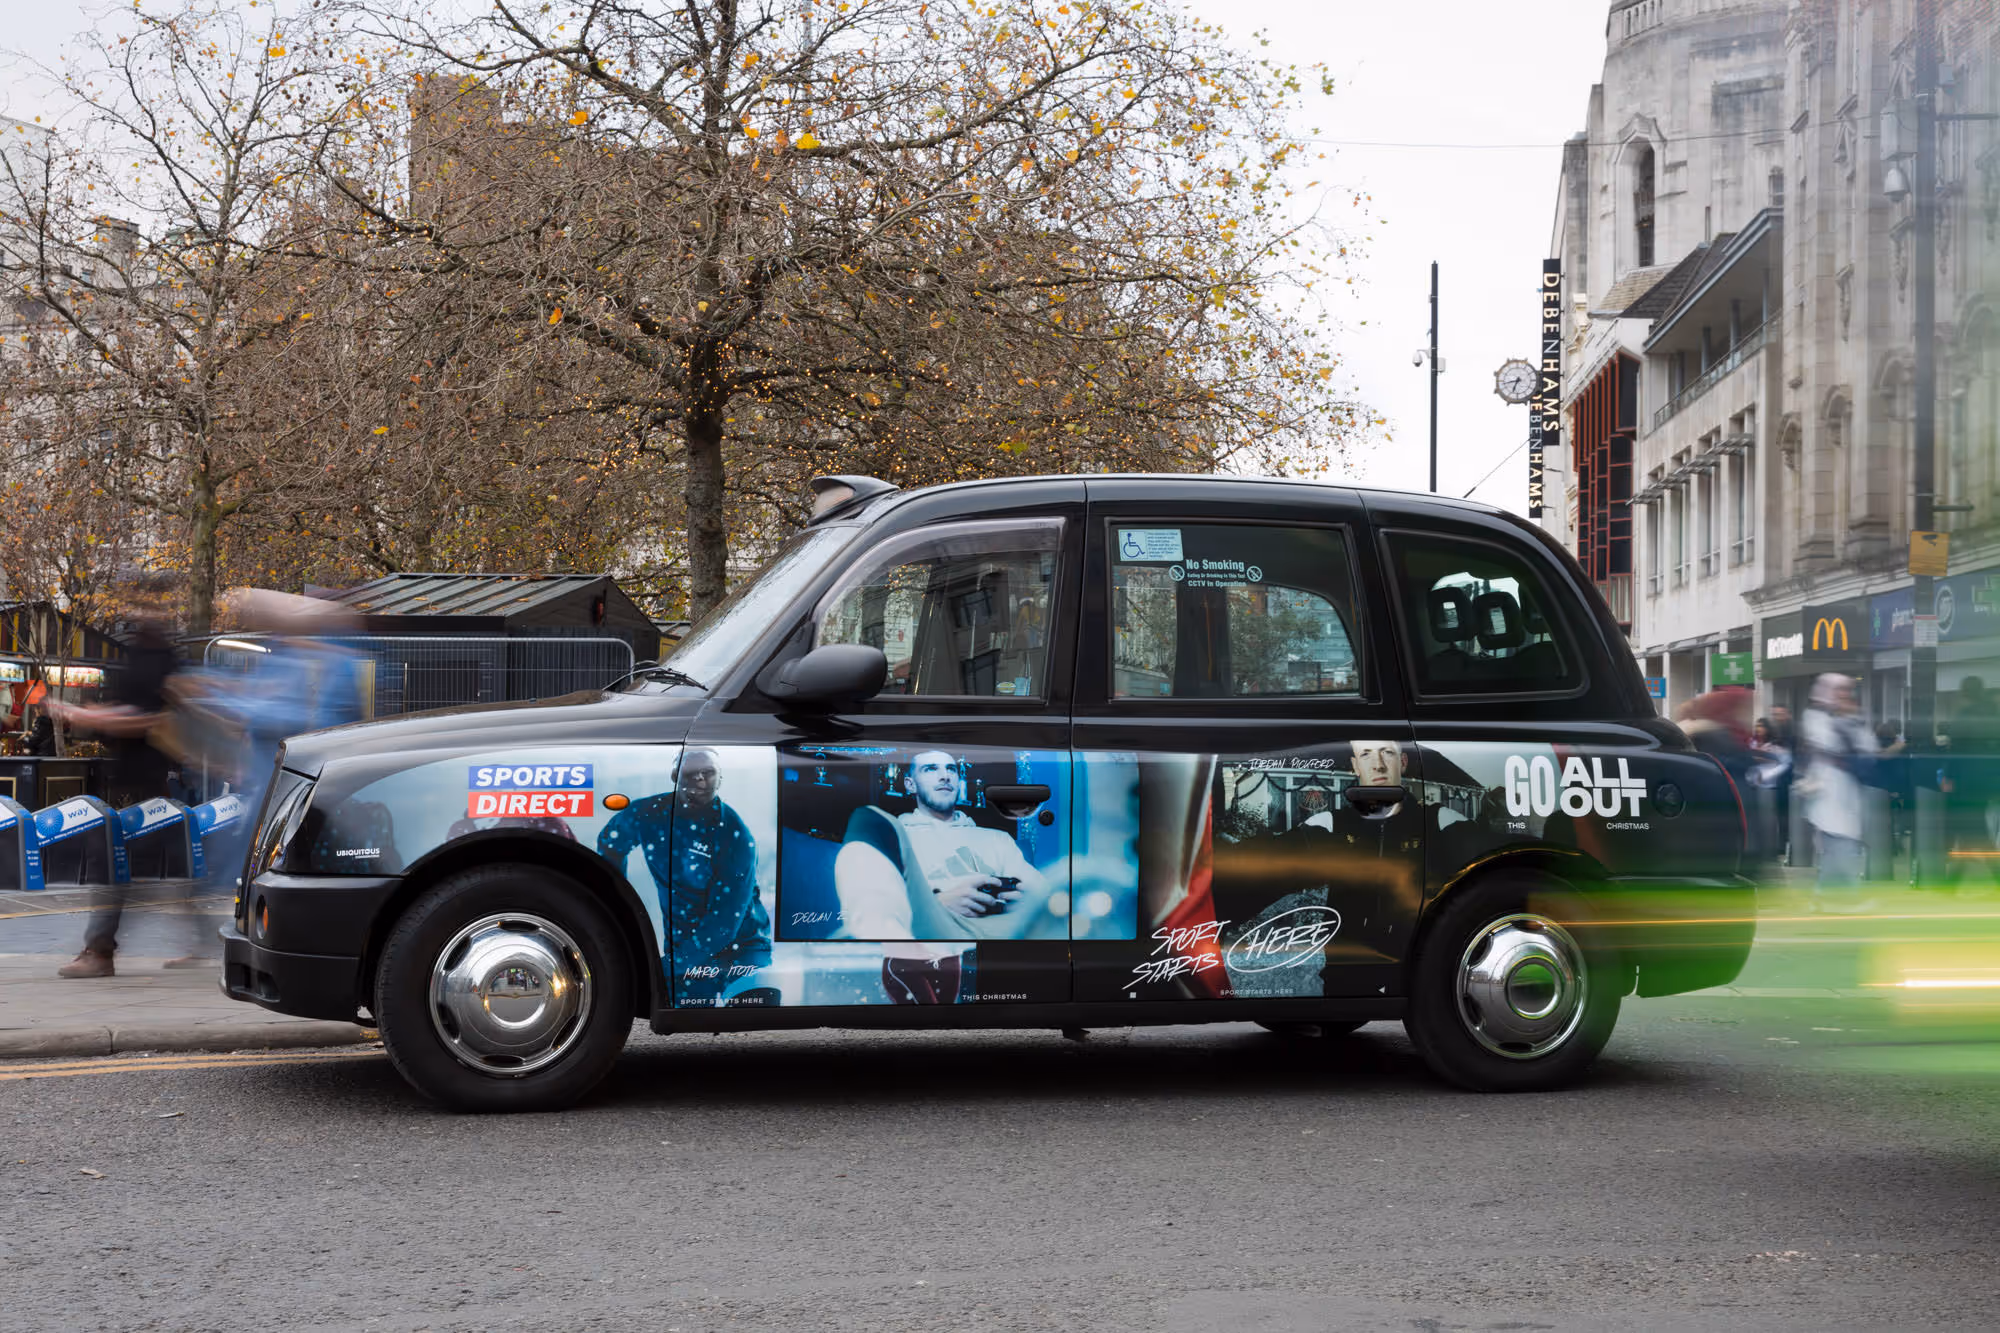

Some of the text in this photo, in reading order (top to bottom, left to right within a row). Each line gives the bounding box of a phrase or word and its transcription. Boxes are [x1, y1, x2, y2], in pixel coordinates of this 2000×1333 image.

[1543, 272, 1560, 432] DEBENHAMS
[1185, 559, 1245, 572] No Smoking
[476, 766, 586, 787] SPORTS
[1505, 755, 1647, 817] GO ALL
[147, 804, 168, 816] way
[476, 794, 586, 815] DIRECT
[1560, 786, 1647, 818] OUT
[67, 807, 89, 819] way
[1606, 822, 1650, 830] CHRISTMAS
[336, 848, 380, 857] UBIQUITOUS
[792, 911, 832, 925] DECLAN
[1151, 920, 1232, 956] SPORT
[1245, 920, 1337, 961] HERE
[683, 966, 720, 980] MARO
[1122, 952, 1219, 990] STARTS
